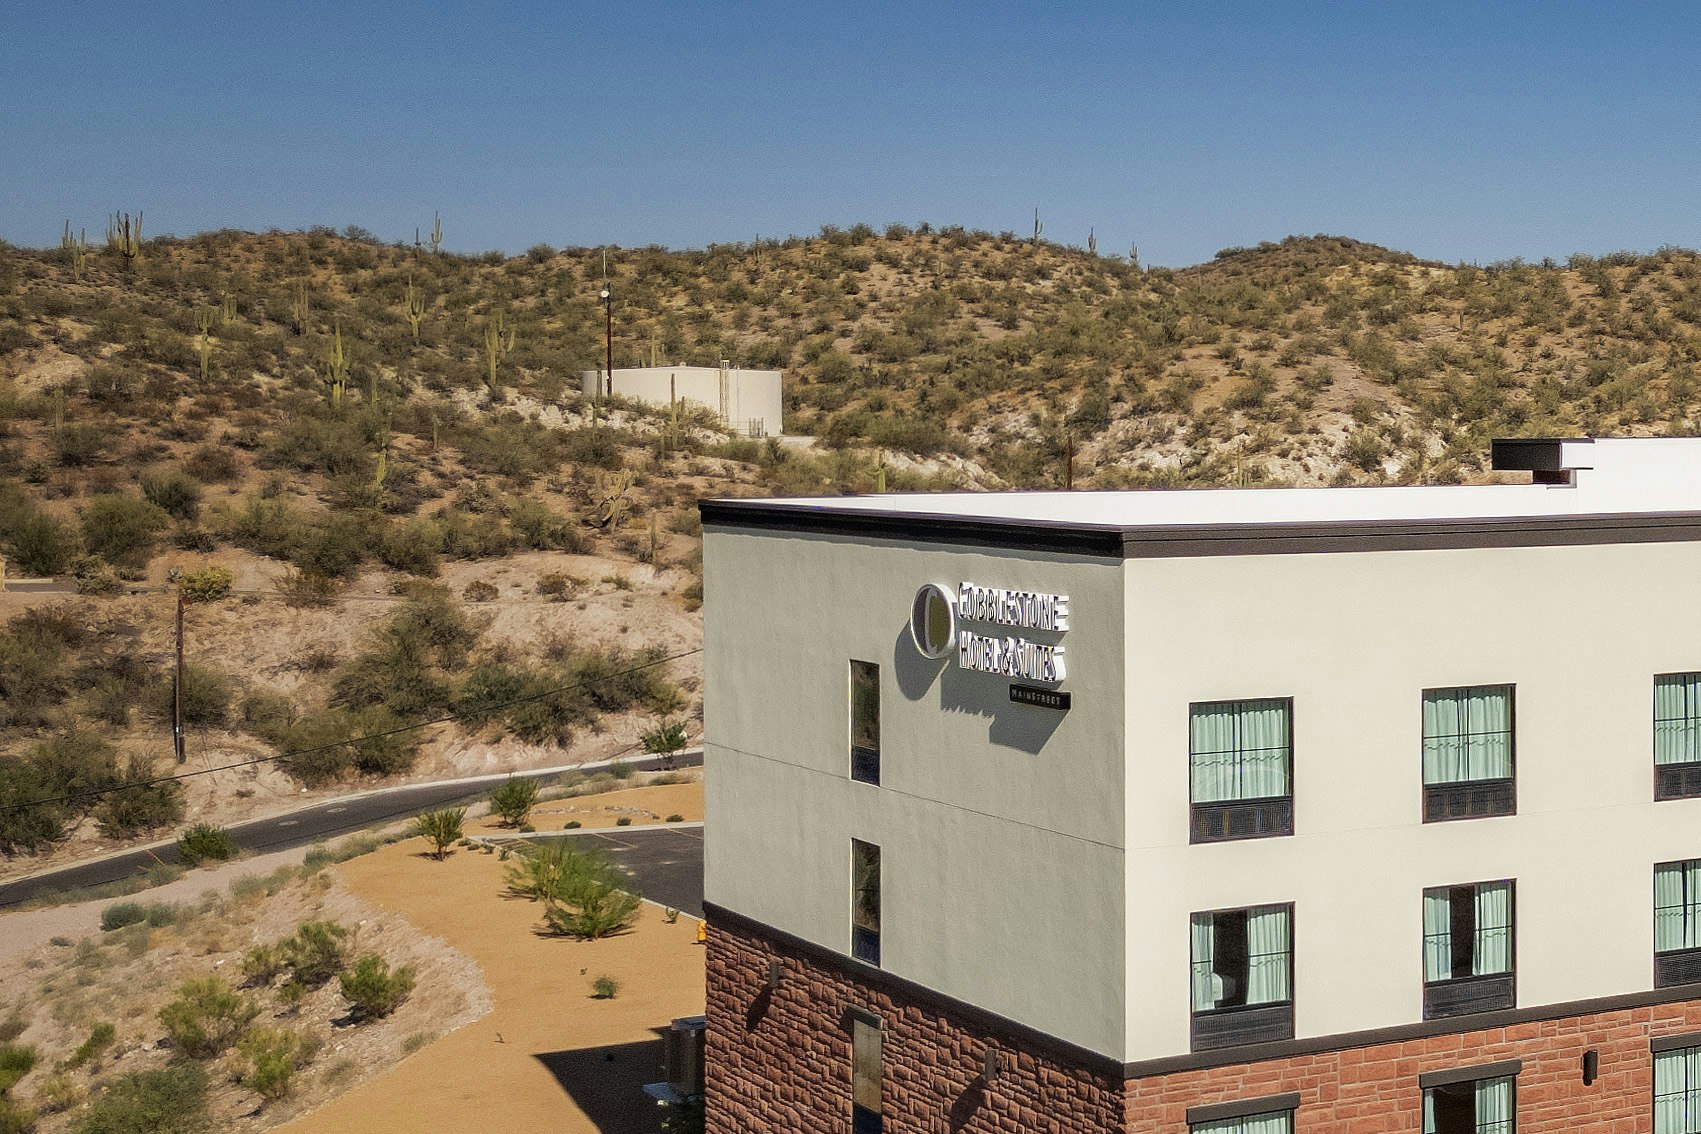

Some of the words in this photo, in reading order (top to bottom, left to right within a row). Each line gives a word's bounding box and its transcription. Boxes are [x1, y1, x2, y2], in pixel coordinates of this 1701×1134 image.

[957, 582, 1068, 631] COBBLESTONE
[960, 631, 1000, 674] HOTEL
[1001, 637, 1015, 677] &
[1014, 638, 1065, 682] SUITES
[1011, 689, 1060, 706] MAINSTREET
